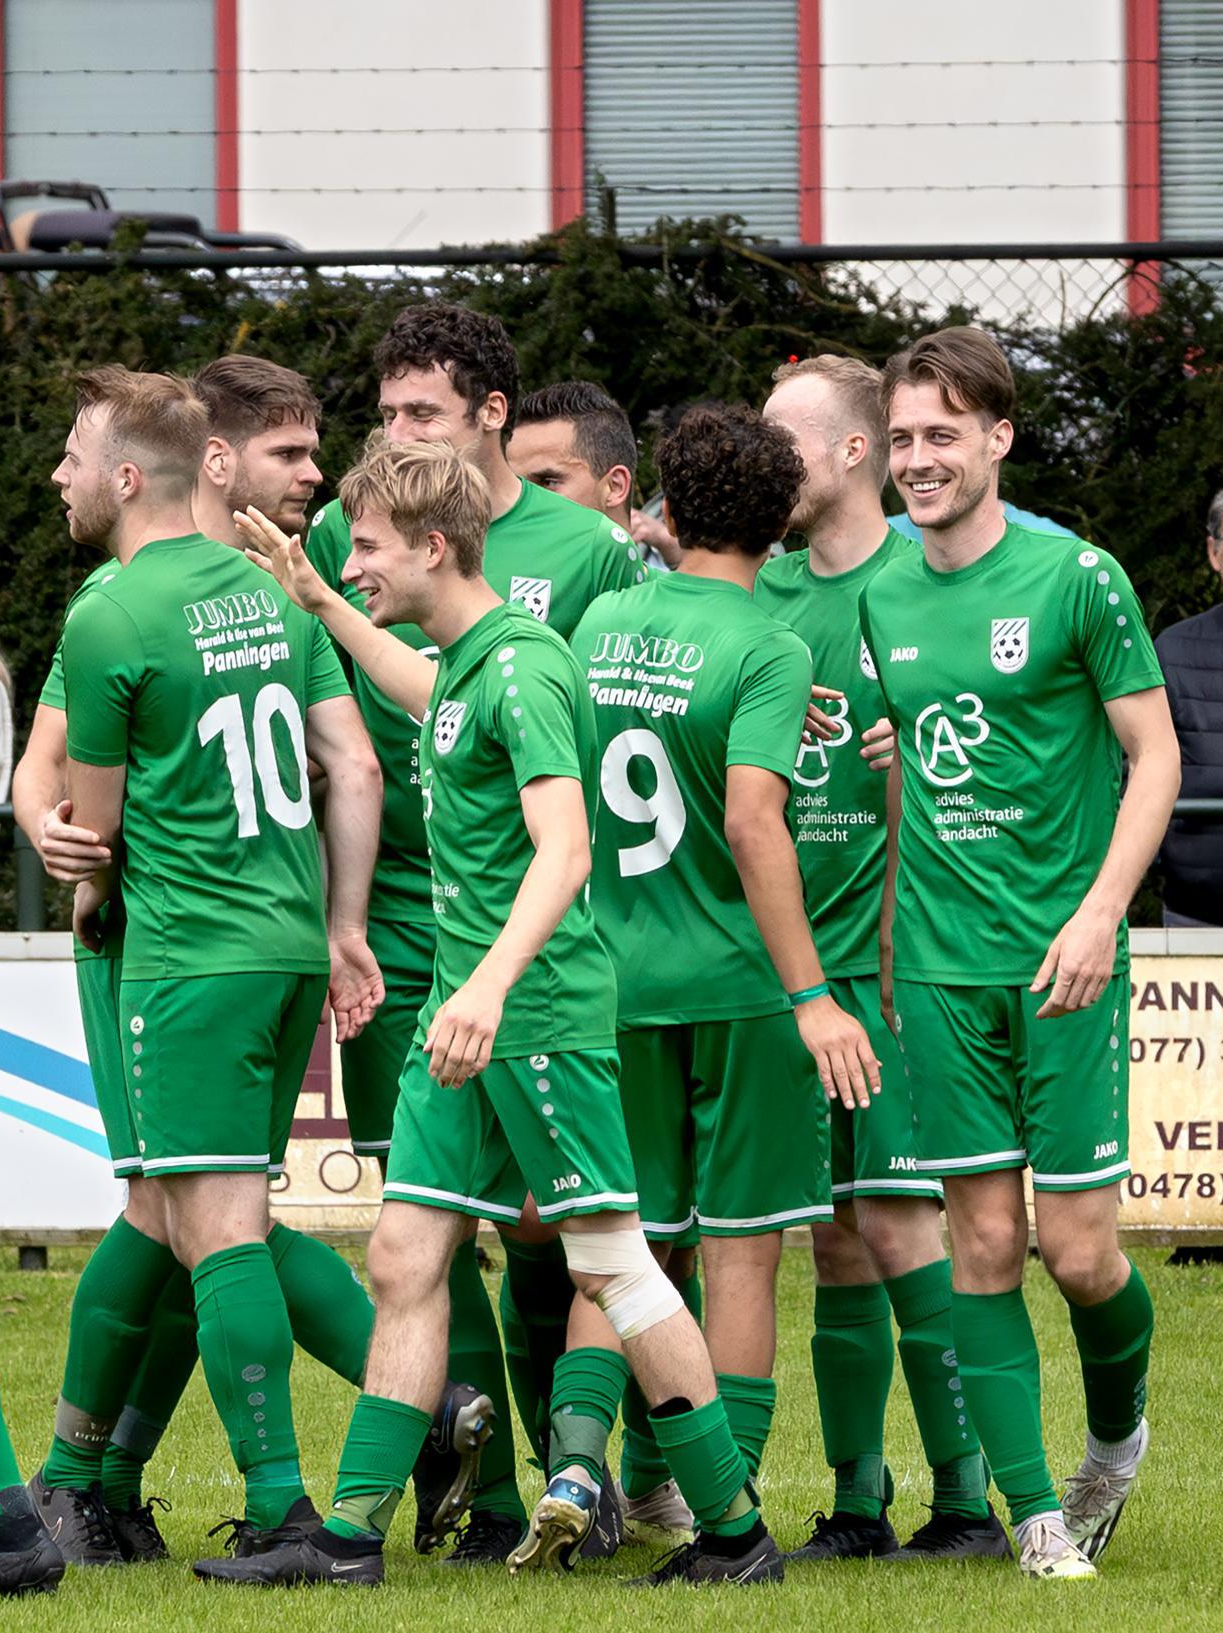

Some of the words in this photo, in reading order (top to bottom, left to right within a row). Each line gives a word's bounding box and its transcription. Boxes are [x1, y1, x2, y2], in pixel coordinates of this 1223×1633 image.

[183, 589, 278, 634] JUMBO
[195, 632, 226, 650] Harald
[226, 629, 235, 642] &
[202, 641, 290, 676] Panningen
[589, 632, 703, 672] JUMBO
[889, 646, 919, 663] JAKO
[620, 667, 633, 680] &
[197, 683, 313, 838] 10
[600, 728, 687, 877] 9
[795, 792, 829, 807] advies
[935, 791, 975, 807] advies
[797, 810, 877, 825] administratie
[934, 806, 1024, 825] administratie
[1093, 1140, 1118, 1159] JAKO
[888, 1156, 917, 1172] JAK
